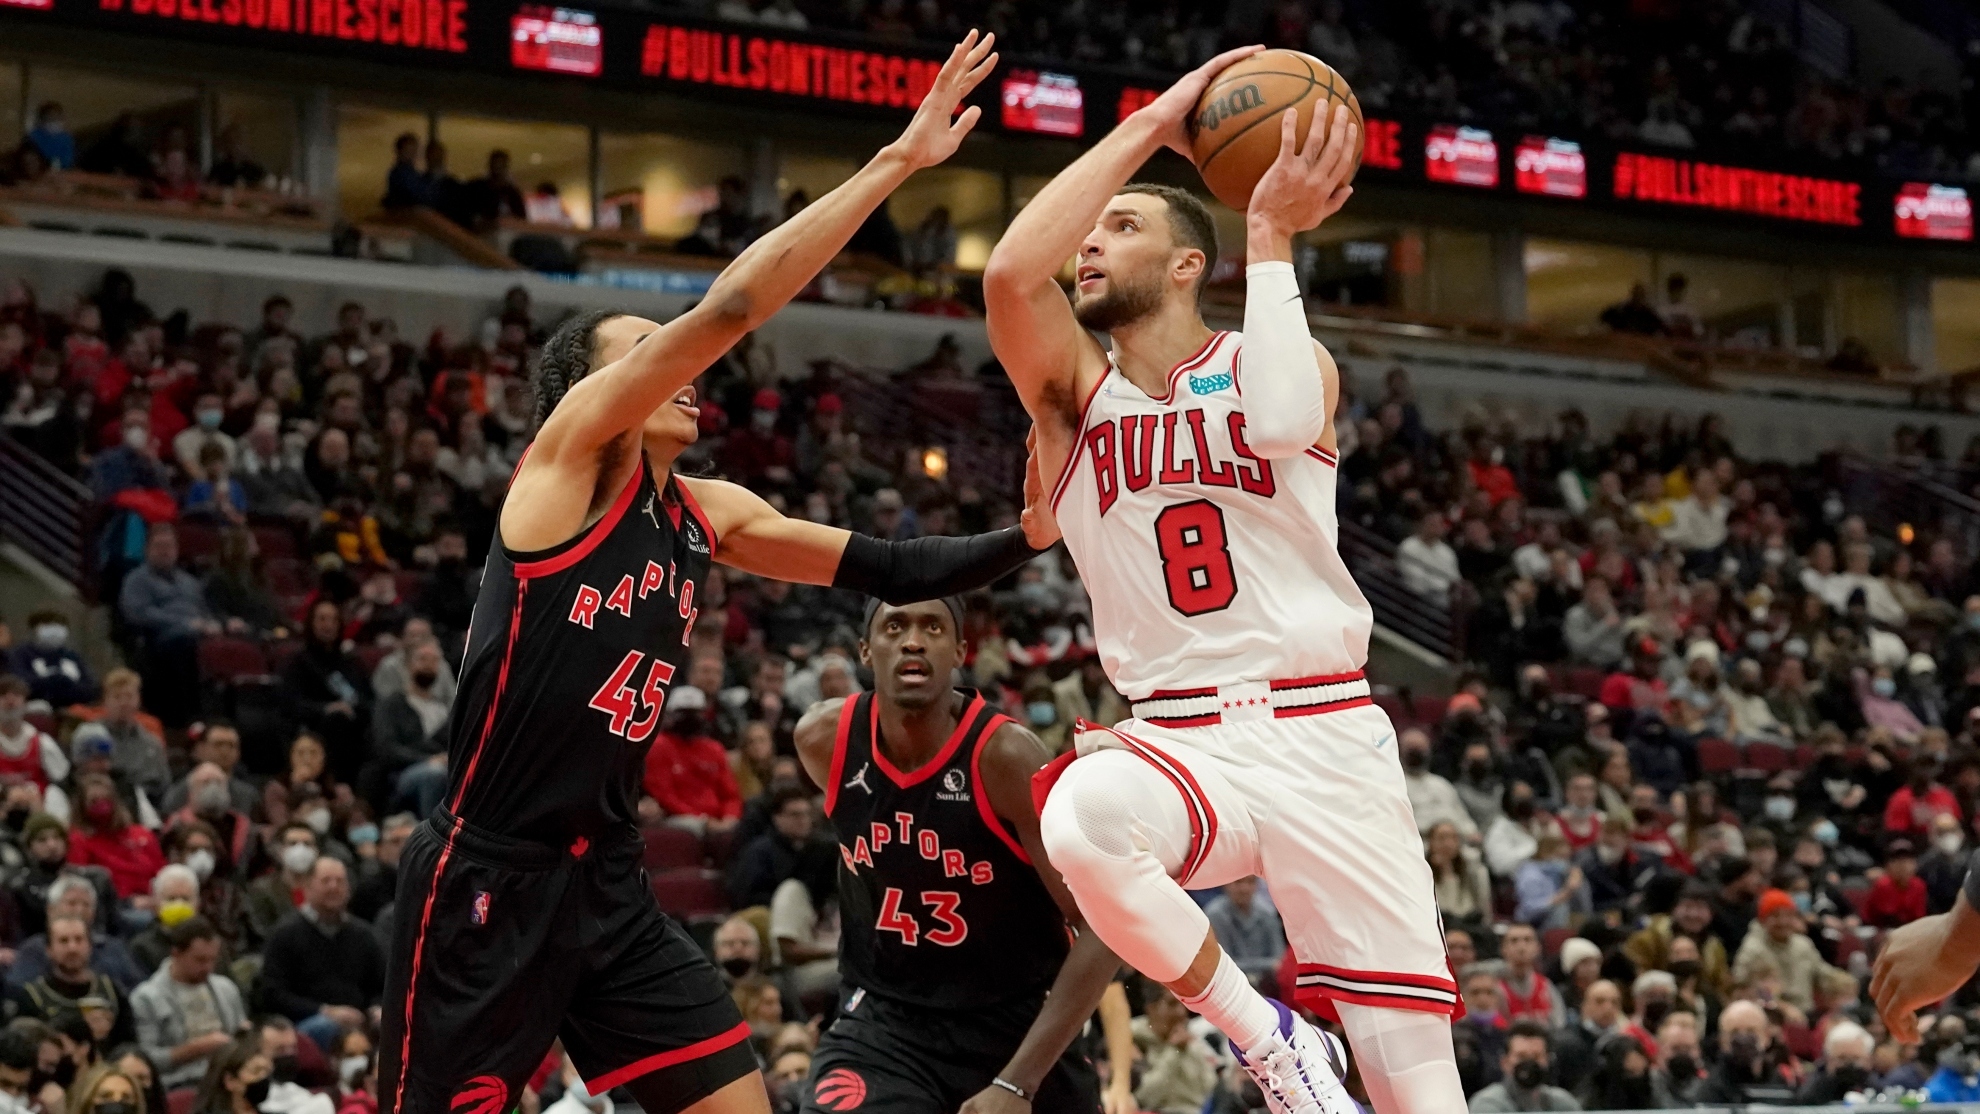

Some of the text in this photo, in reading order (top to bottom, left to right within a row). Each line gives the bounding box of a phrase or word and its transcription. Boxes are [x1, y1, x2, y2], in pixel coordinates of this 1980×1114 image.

[99, 0, 468, 52] SONTHESCORE
[641, 24, 966, 115] #BULLSONTHESCO
[1086, 408, 1276, 518] BULLS
[1154, 498, 1238, 617] 8
[568, 558, 698, 647] RAPTOR
[588, 649, 676, 742] 45
[936, 791, 971, 802] Sun Life
[839, 811, 994, 885] RAPTORS
[875, 887, 968, 947] 43
